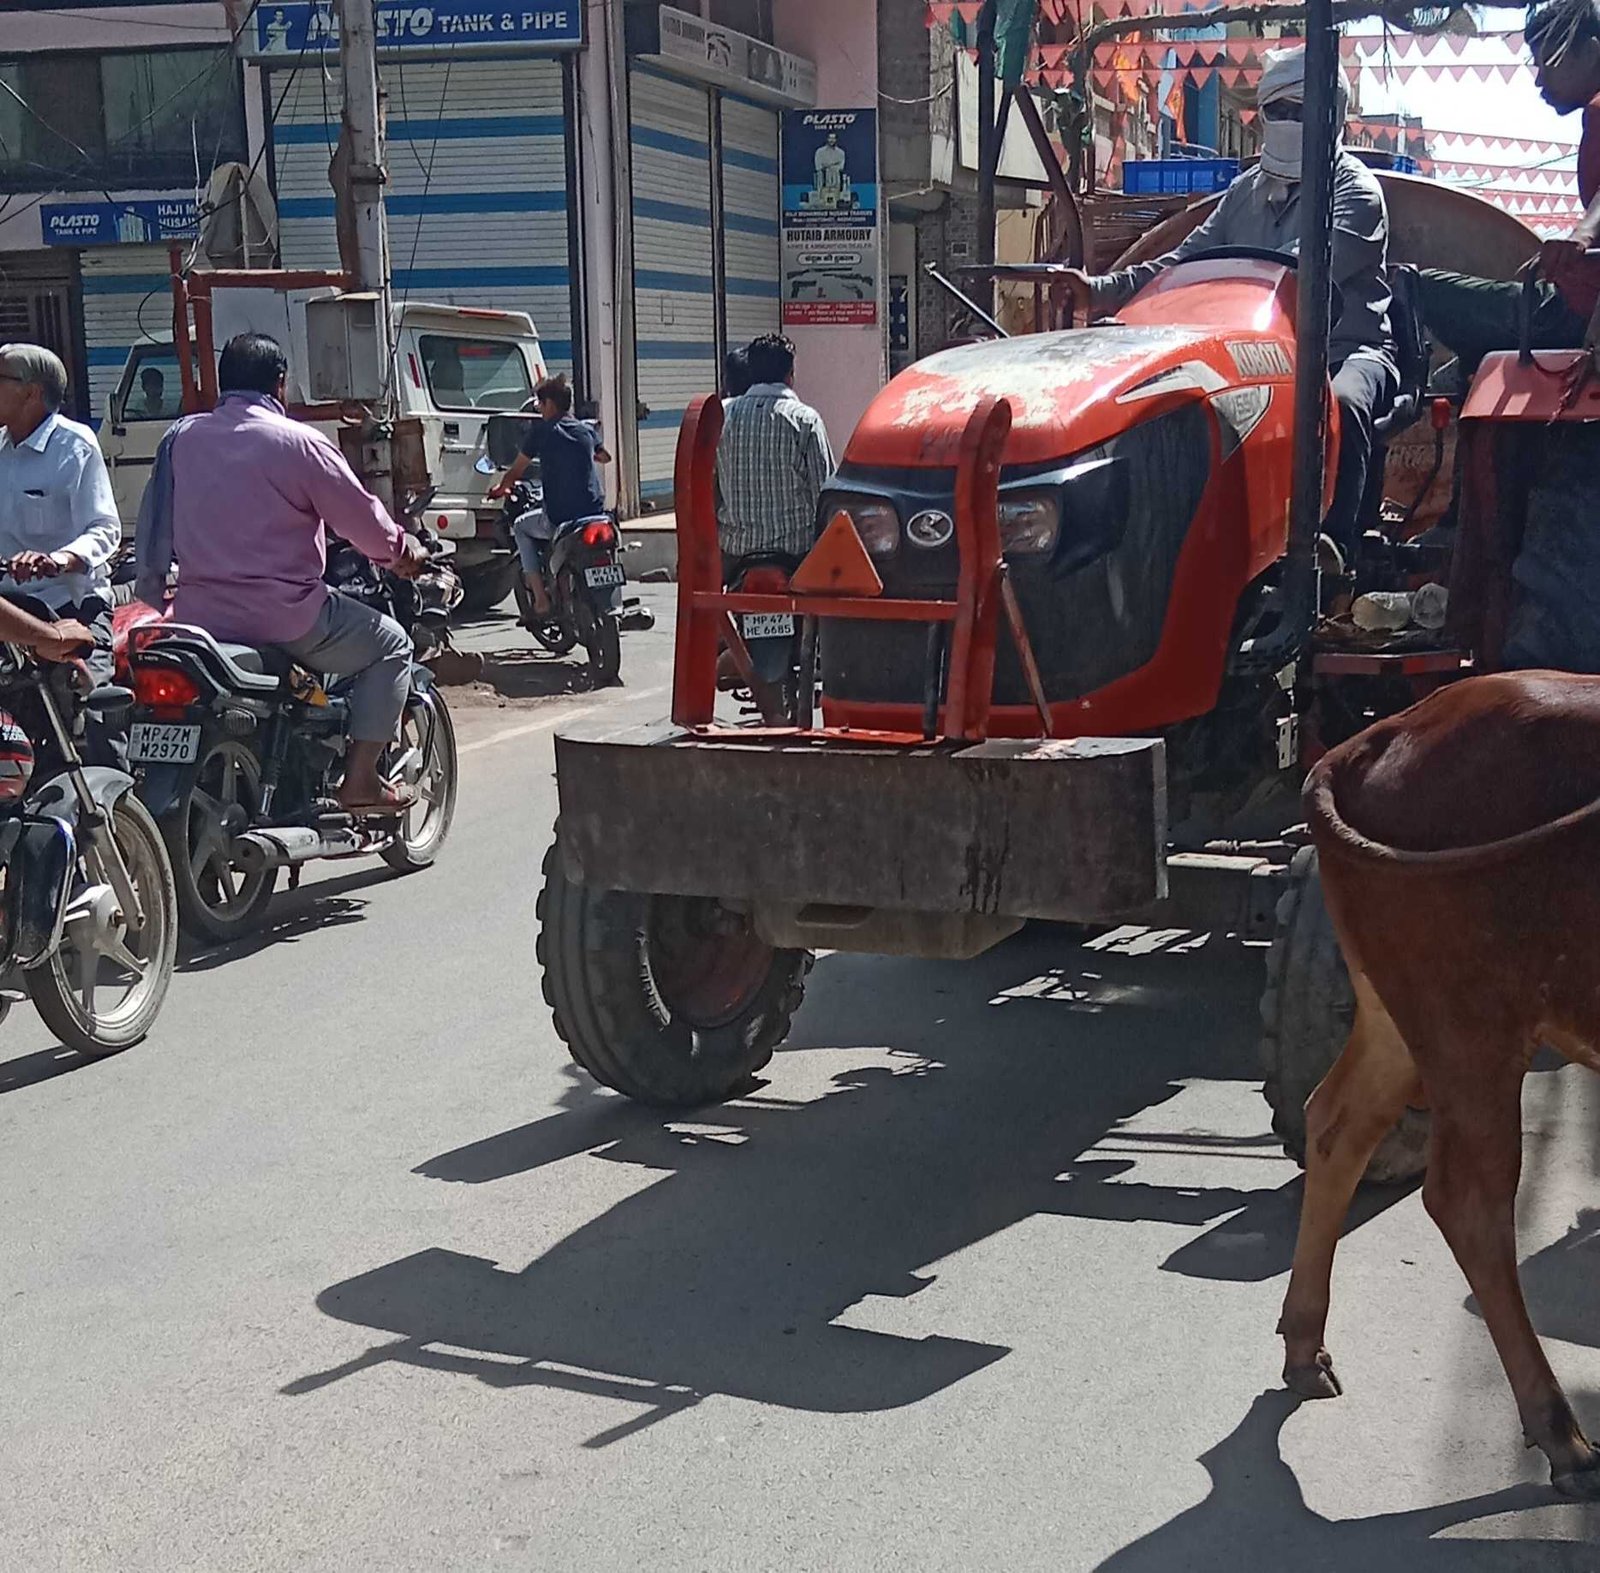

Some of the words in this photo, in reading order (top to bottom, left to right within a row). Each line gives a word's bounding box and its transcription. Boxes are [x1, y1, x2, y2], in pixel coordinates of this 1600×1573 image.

[438, 14, 494, 33] TANK
[500, 13, 514, 31] &
[521, 12, 567, 30] PIPE
[803, 113, 856, 125] PLASTO
[158, 204, 183, 216] HAJI
[50, 214, 99, 228] PLASTO
[824, 229, 872, 241] ARMOURY
[1226, 342, 1293, 377] KUBOTA
[753, 615, 767, 625] MP
[770, 614, 783, 624] 47
[746, 626, 760, 637] ME
[763, 624, 791, 635] 6685
[141, 726, 191, 743] MP47M
[139, 742, 189, 759] M2970
